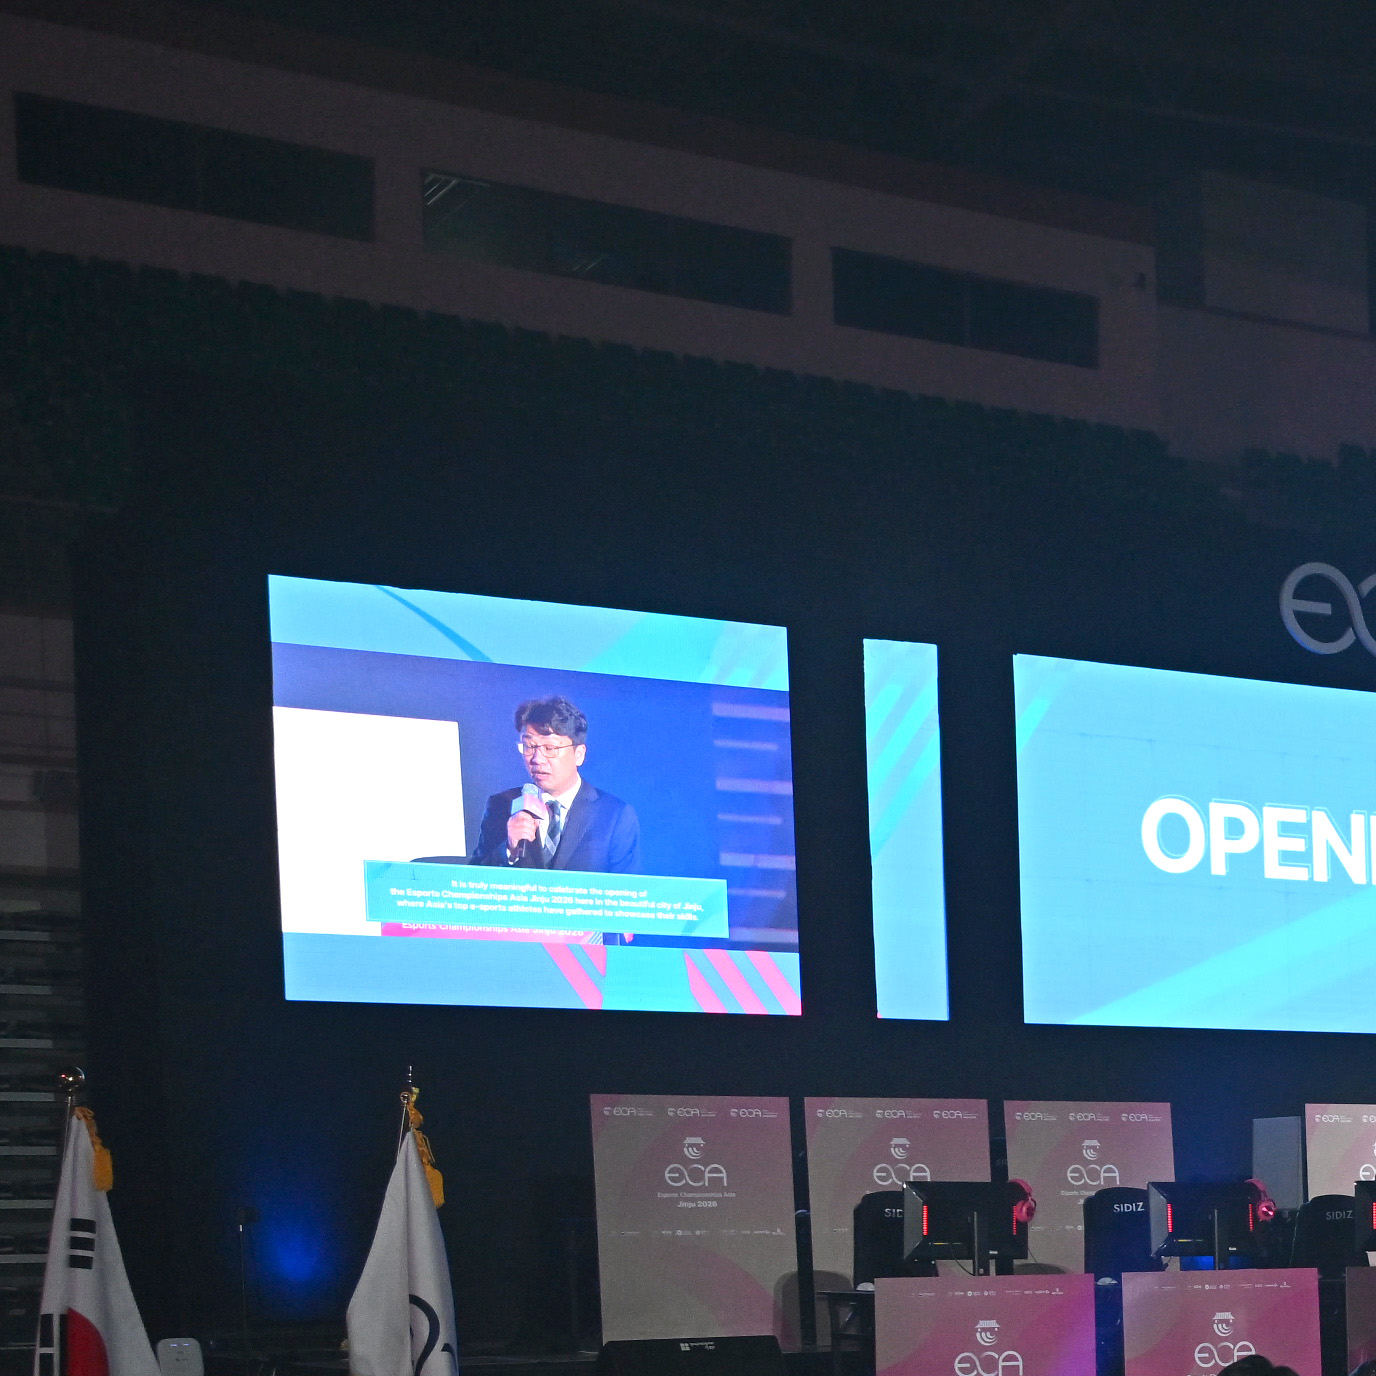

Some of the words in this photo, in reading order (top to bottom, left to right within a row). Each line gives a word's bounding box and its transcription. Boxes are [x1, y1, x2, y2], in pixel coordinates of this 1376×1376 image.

[390, 888, 405, 896] the
[407, 889, 440, 898] Esports
[441, 890, 508, 901] Championships
[510, 894, 528, 902] Asia
[530, 895, 550, 904] Jinju
[552, 896, 574, 904] 2026
[575, 897, 594, 905] here
[620, 899, 656, 909] beautiful
[657, 901, 672, 910] city
[468, 881, 488, 890] truly
[489, 882, 537, 892] meaningful
[549, 886, 587, 895] celebrate
[604, 889, 638, 899] opening
[426, 901, 452, 909] Asia's
[454, 902, 468, 911] top
[470, 903, 507, 912] e-sports
[508, 904, 542, 913] athletes
[543, 906, 564, 914] have
[565, 907, 604, 917] gathered
[615, 910, 655, 919] showcase
[656, 911, 675, 920] their
[664, 1164, 727, 1187] ECA
[873, 1163, 931, 1185] ECA
[1067, 1165, 1119, 1186] ECA
[885, 1208, 905, 1218] SID
[1113, 1202, 1145, 1212] SIDIZ
[1326, 1210, 1353, 1220] SIDIZ
[1194, 1341, 1256, 1367] ECA
